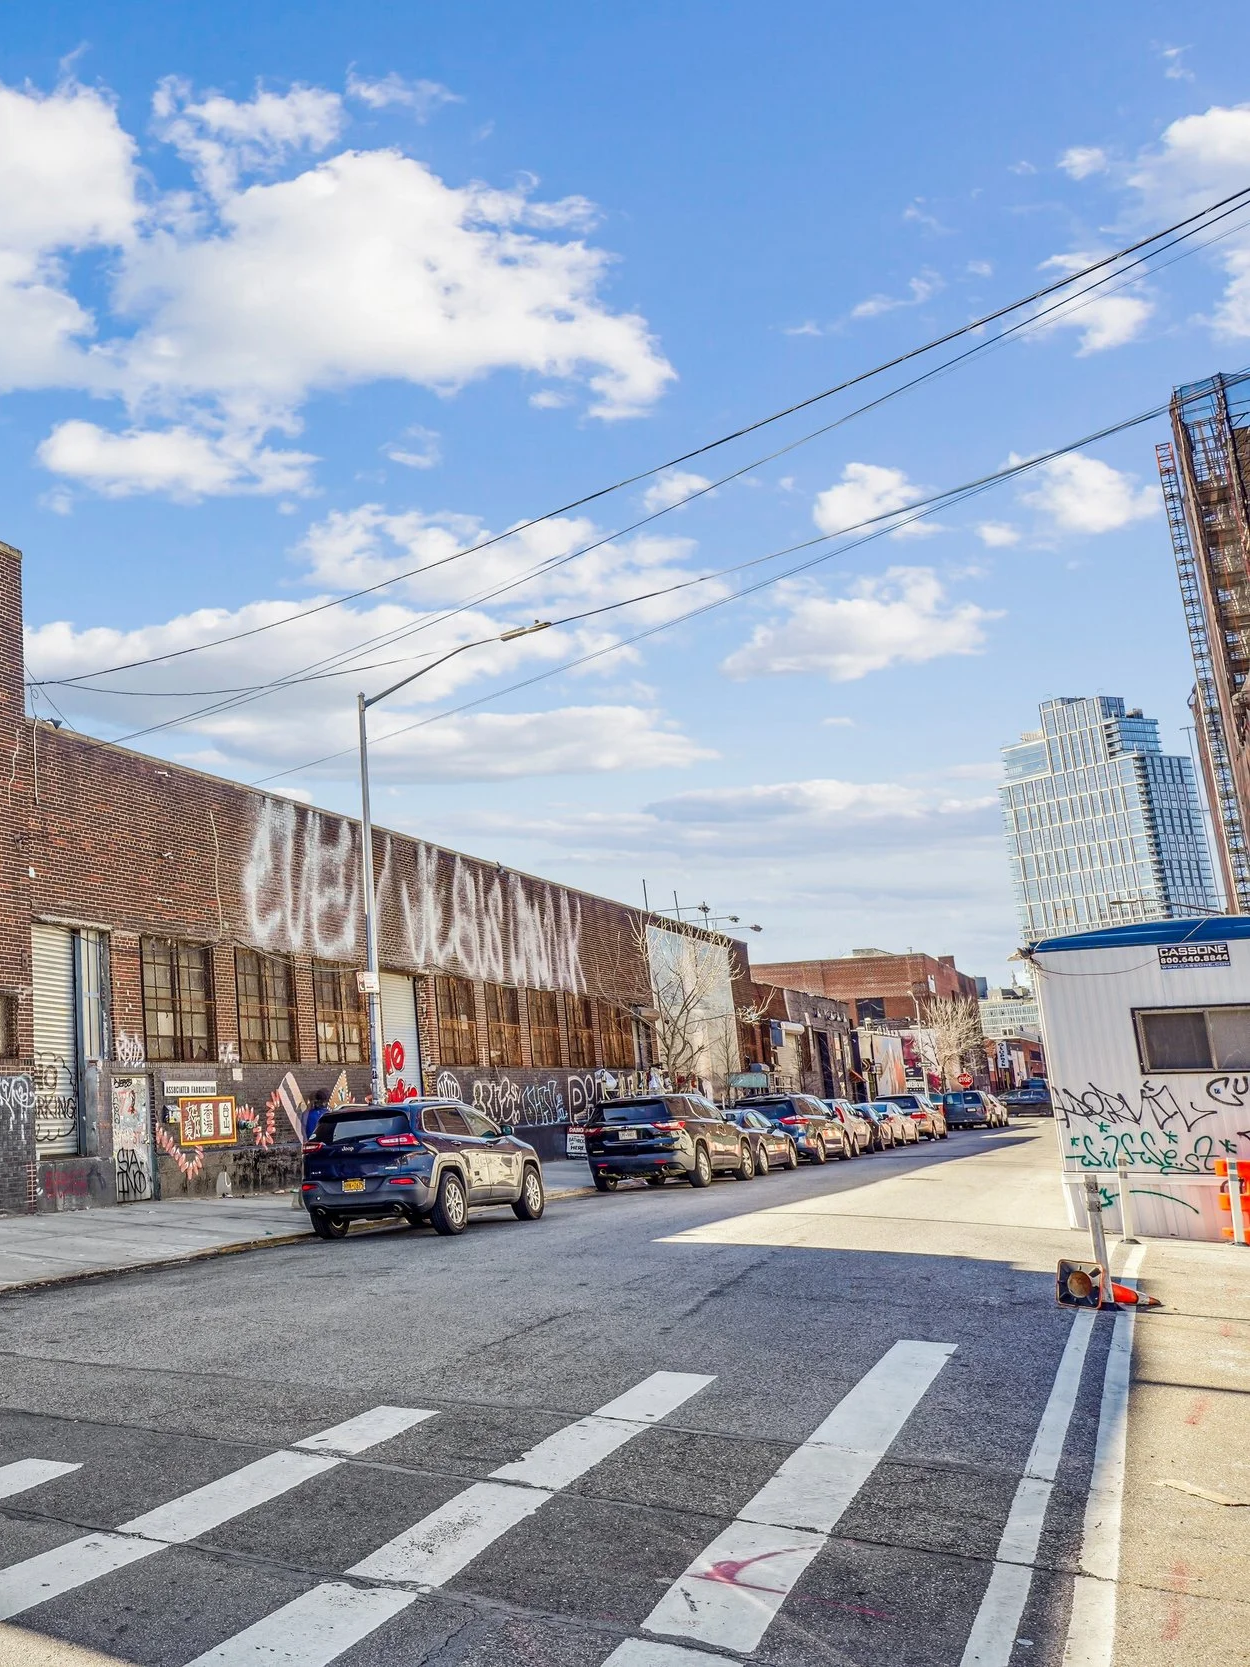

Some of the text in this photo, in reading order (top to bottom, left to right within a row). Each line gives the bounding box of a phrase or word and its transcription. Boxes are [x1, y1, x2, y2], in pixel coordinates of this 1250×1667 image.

[1159, 945, 1227, 956] CASSONE
[1160, 954, 1229, 964] 800.640.8844
[166, 1086, 190, 1094] ASSOCIATED
[37, 1095, 76, 1119] RKING
